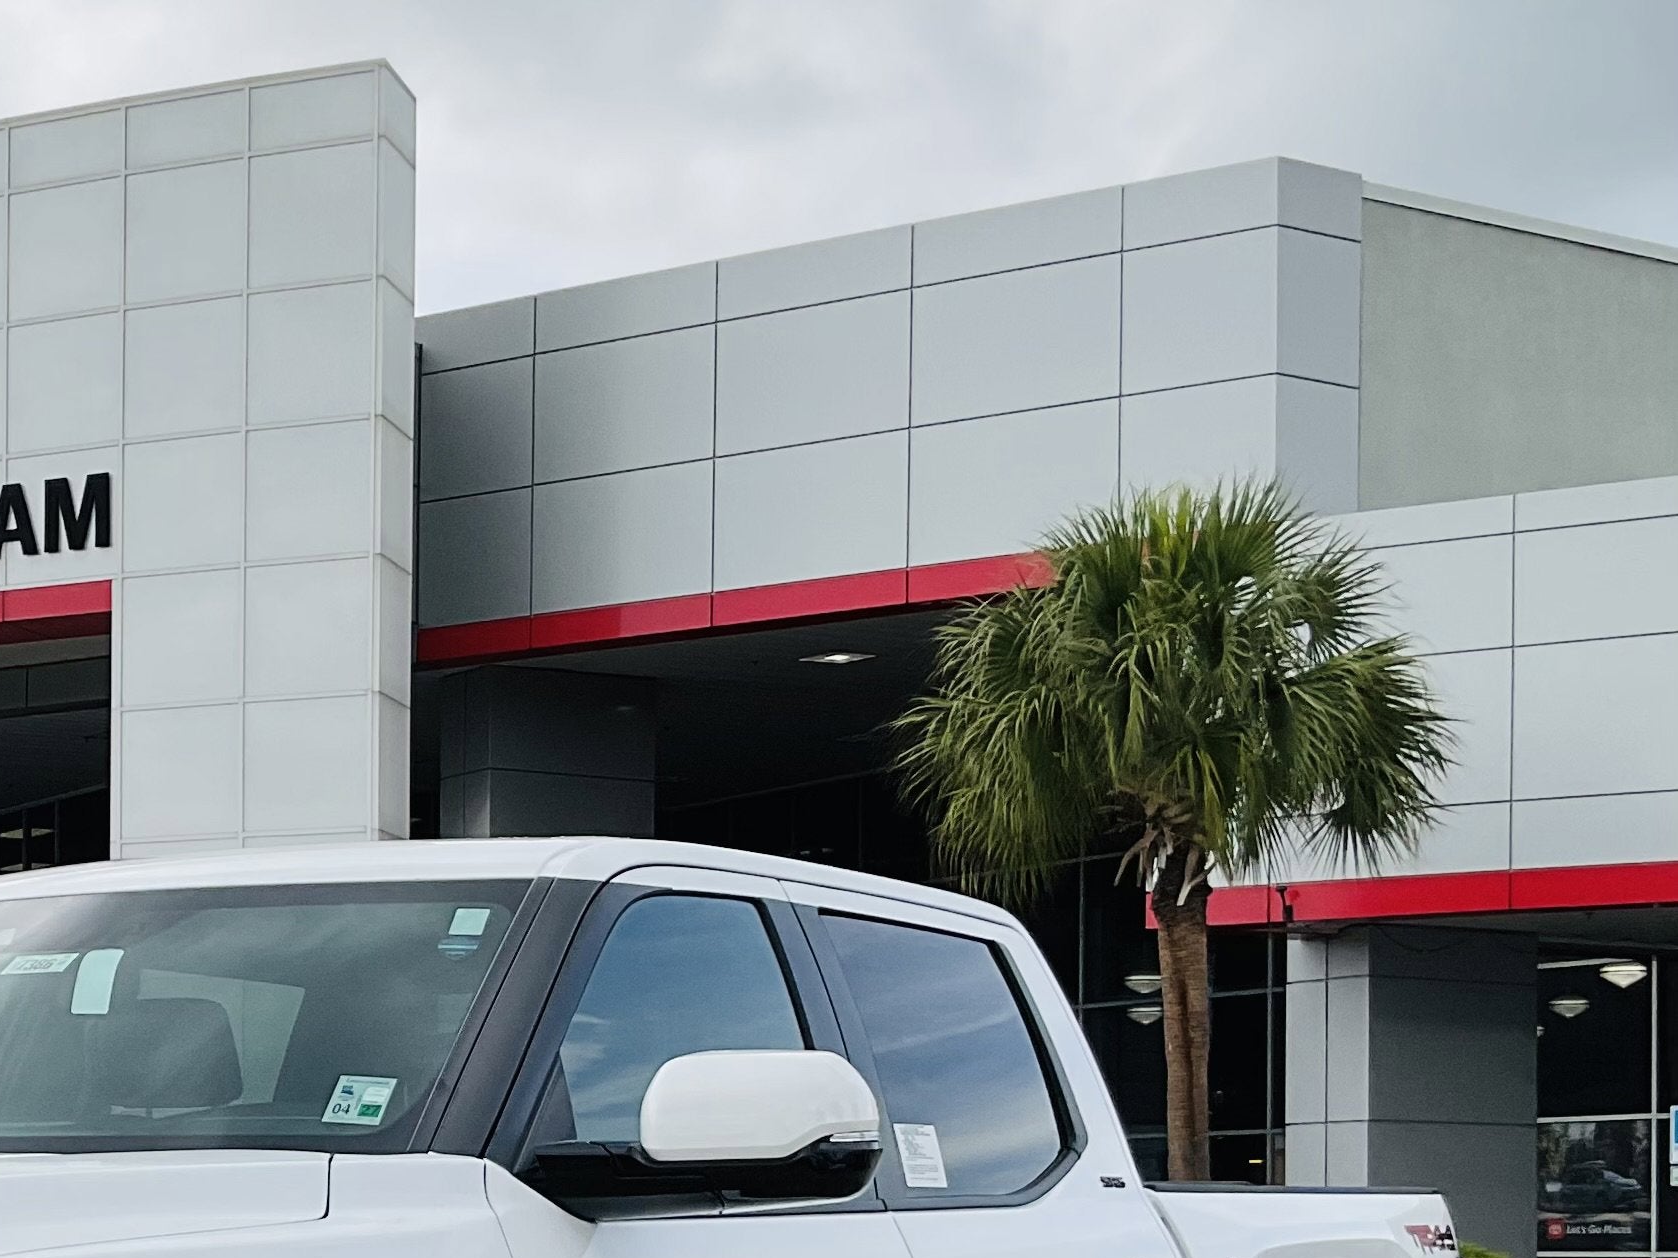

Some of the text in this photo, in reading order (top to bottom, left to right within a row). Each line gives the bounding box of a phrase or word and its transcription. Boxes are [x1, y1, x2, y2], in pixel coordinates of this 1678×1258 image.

[332, 1103, 381, 1115] 04 27
[1588, 1225, 1602, 1234] Go
